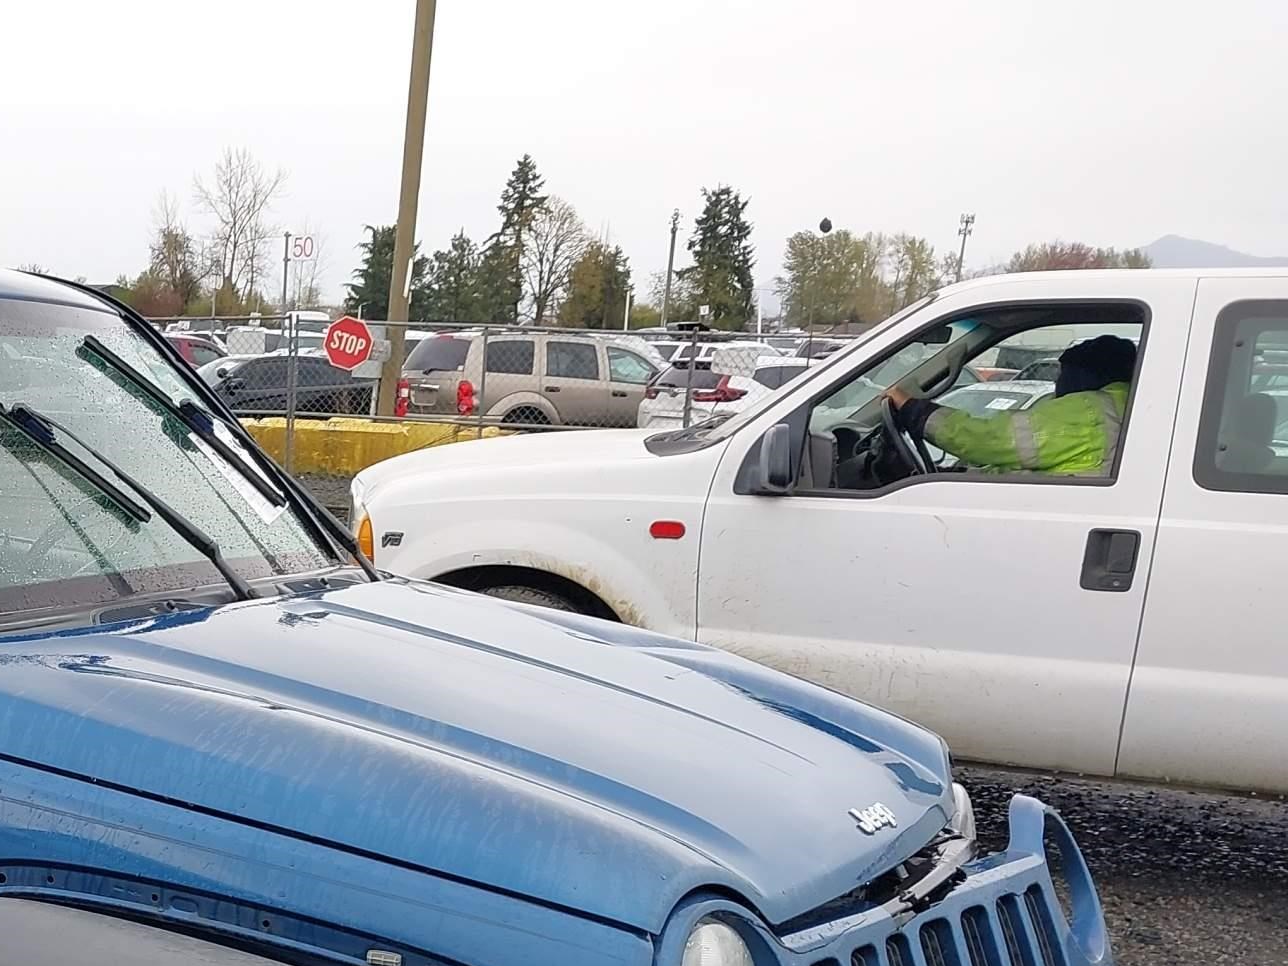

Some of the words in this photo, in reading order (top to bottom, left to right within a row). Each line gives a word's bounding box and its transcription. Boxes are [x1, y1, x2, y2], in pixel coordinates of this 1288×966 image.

[293, 236, 314, 258] 50
[330, 330, 367, 356] STOP
[848, 801, 897, 834] Jeep
